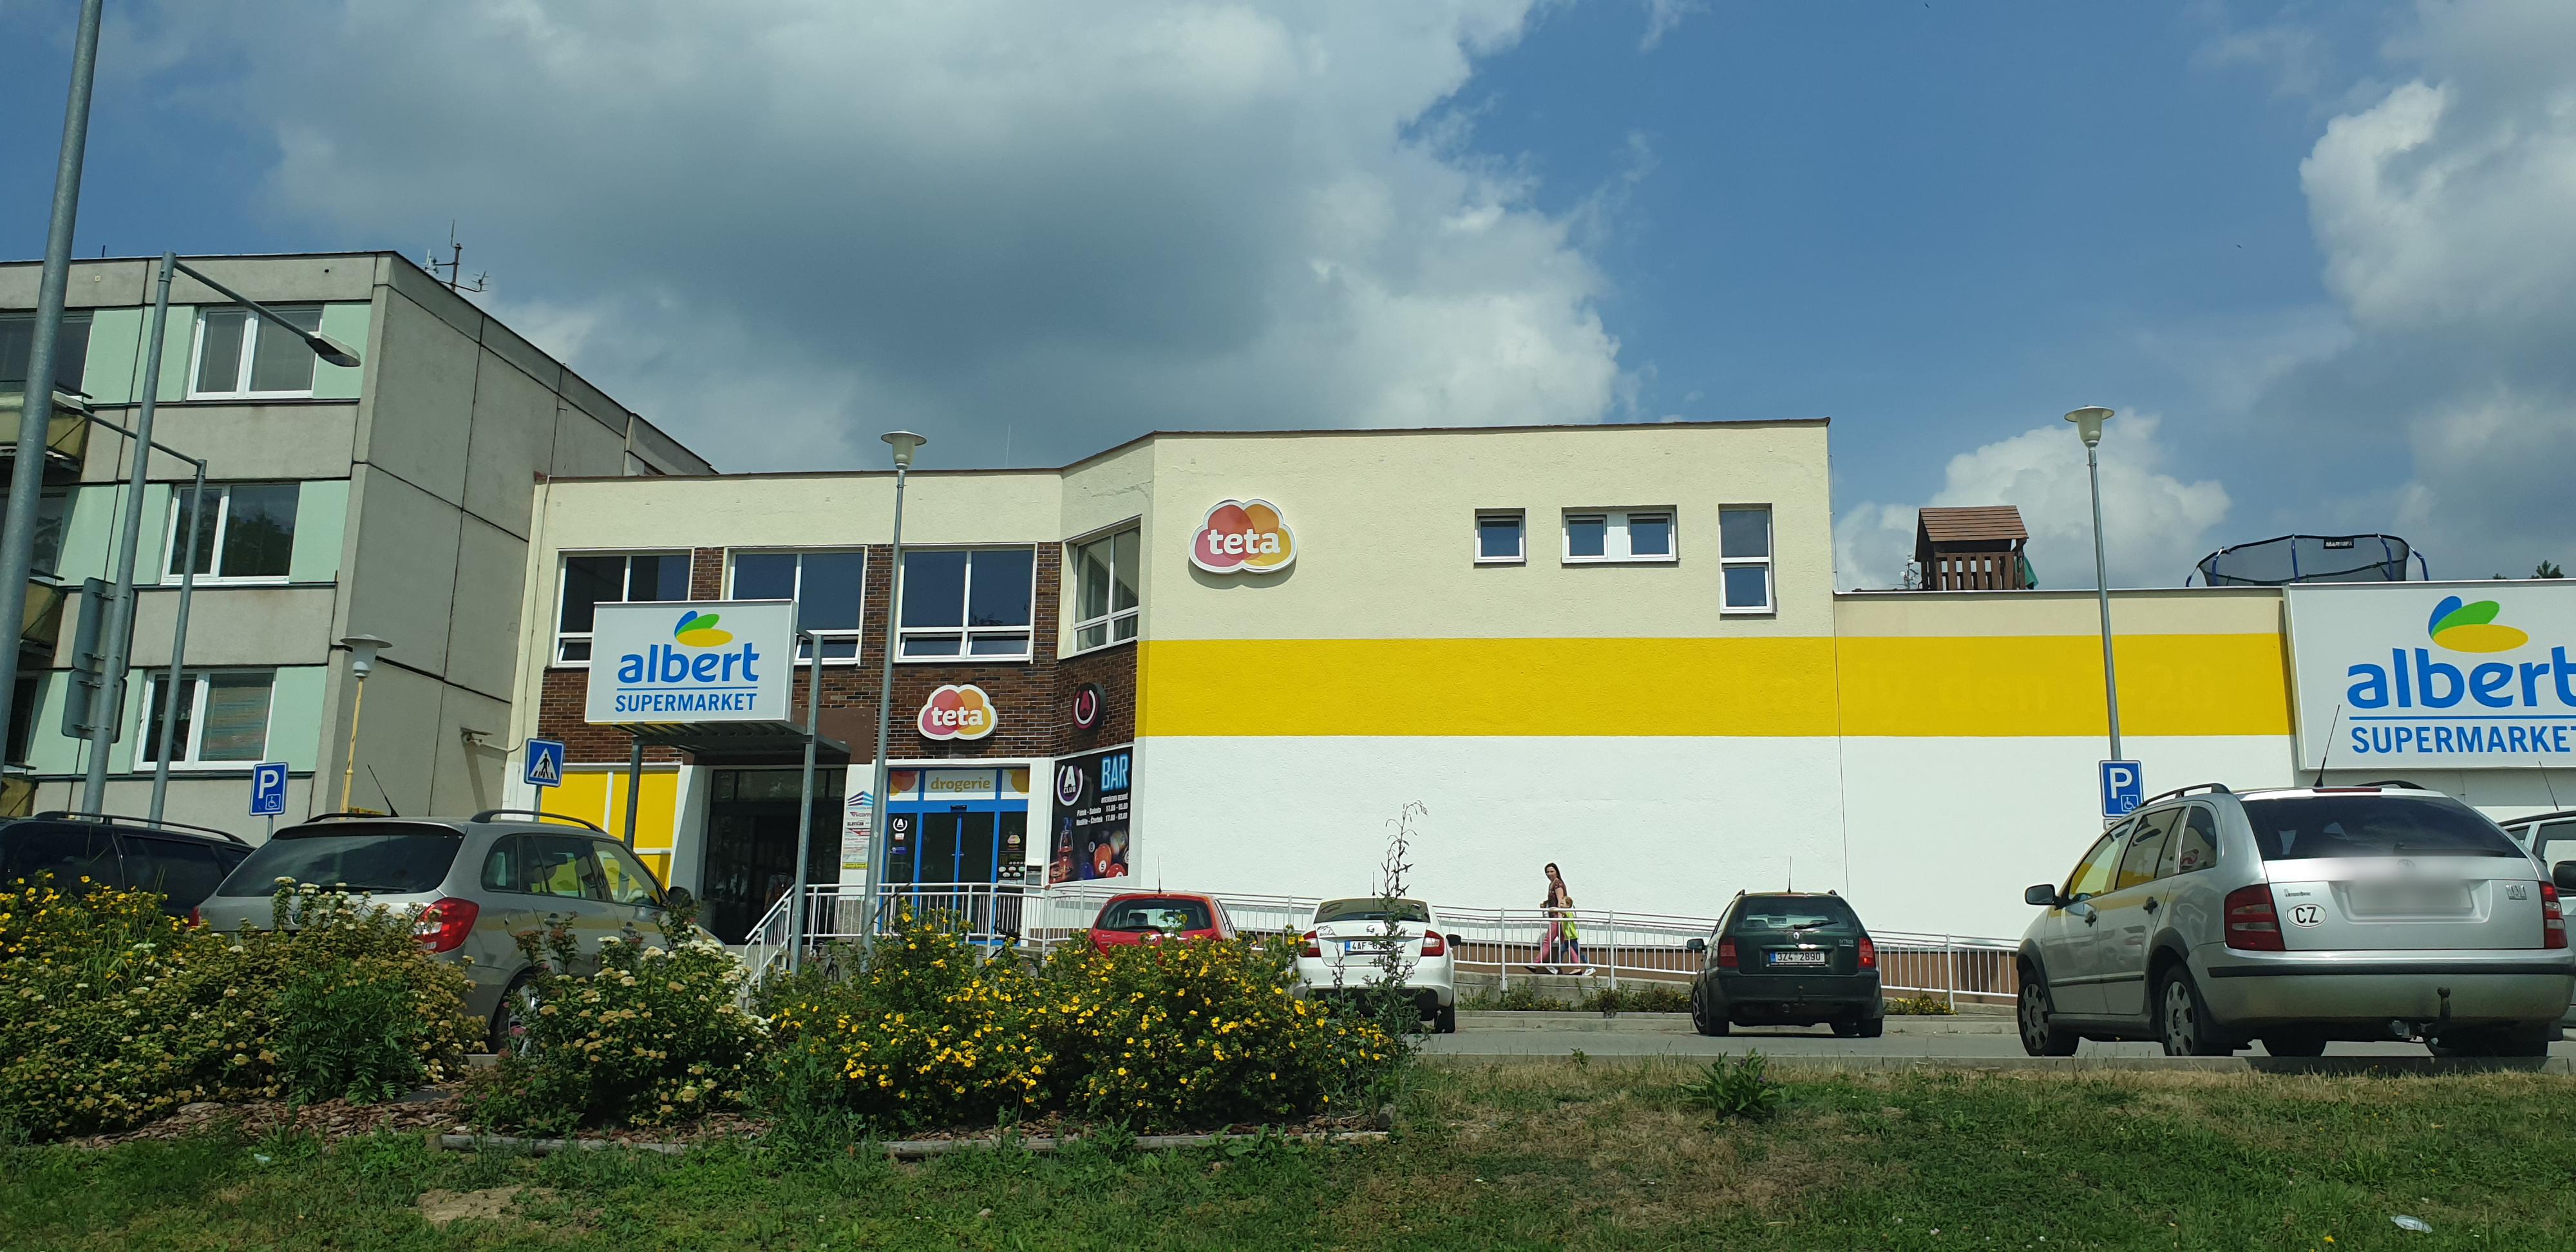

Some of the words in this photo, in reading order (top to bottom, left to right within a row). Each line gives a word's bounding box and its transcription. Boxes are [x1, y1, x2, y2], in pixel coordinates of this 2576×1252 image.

[1208, 529, 1280, 555] teta
[618, 643, 760, 683] albert
[2347, 646, 2576, 709] albert
[615, 693, 757, 712] SUPERMARKET
[931, 707, 983, 726] teta
[2351, 726, 2576, 753] SUPERMARKE
[258, 770, 279, 799] P
[1064, 766, 1076, 787] A
[1101, 754, 1129, 792] BAR
[2109, 768, 2132, 799] P
[931, 777, 990, 793] drogerie
[2295, 907, 2318, 924] CZ
[1352, 942, 1366, 950] 4AF
[1777, 953, 1793, 961] 3Z4
[1800, 953, 1821, 961] 2890
